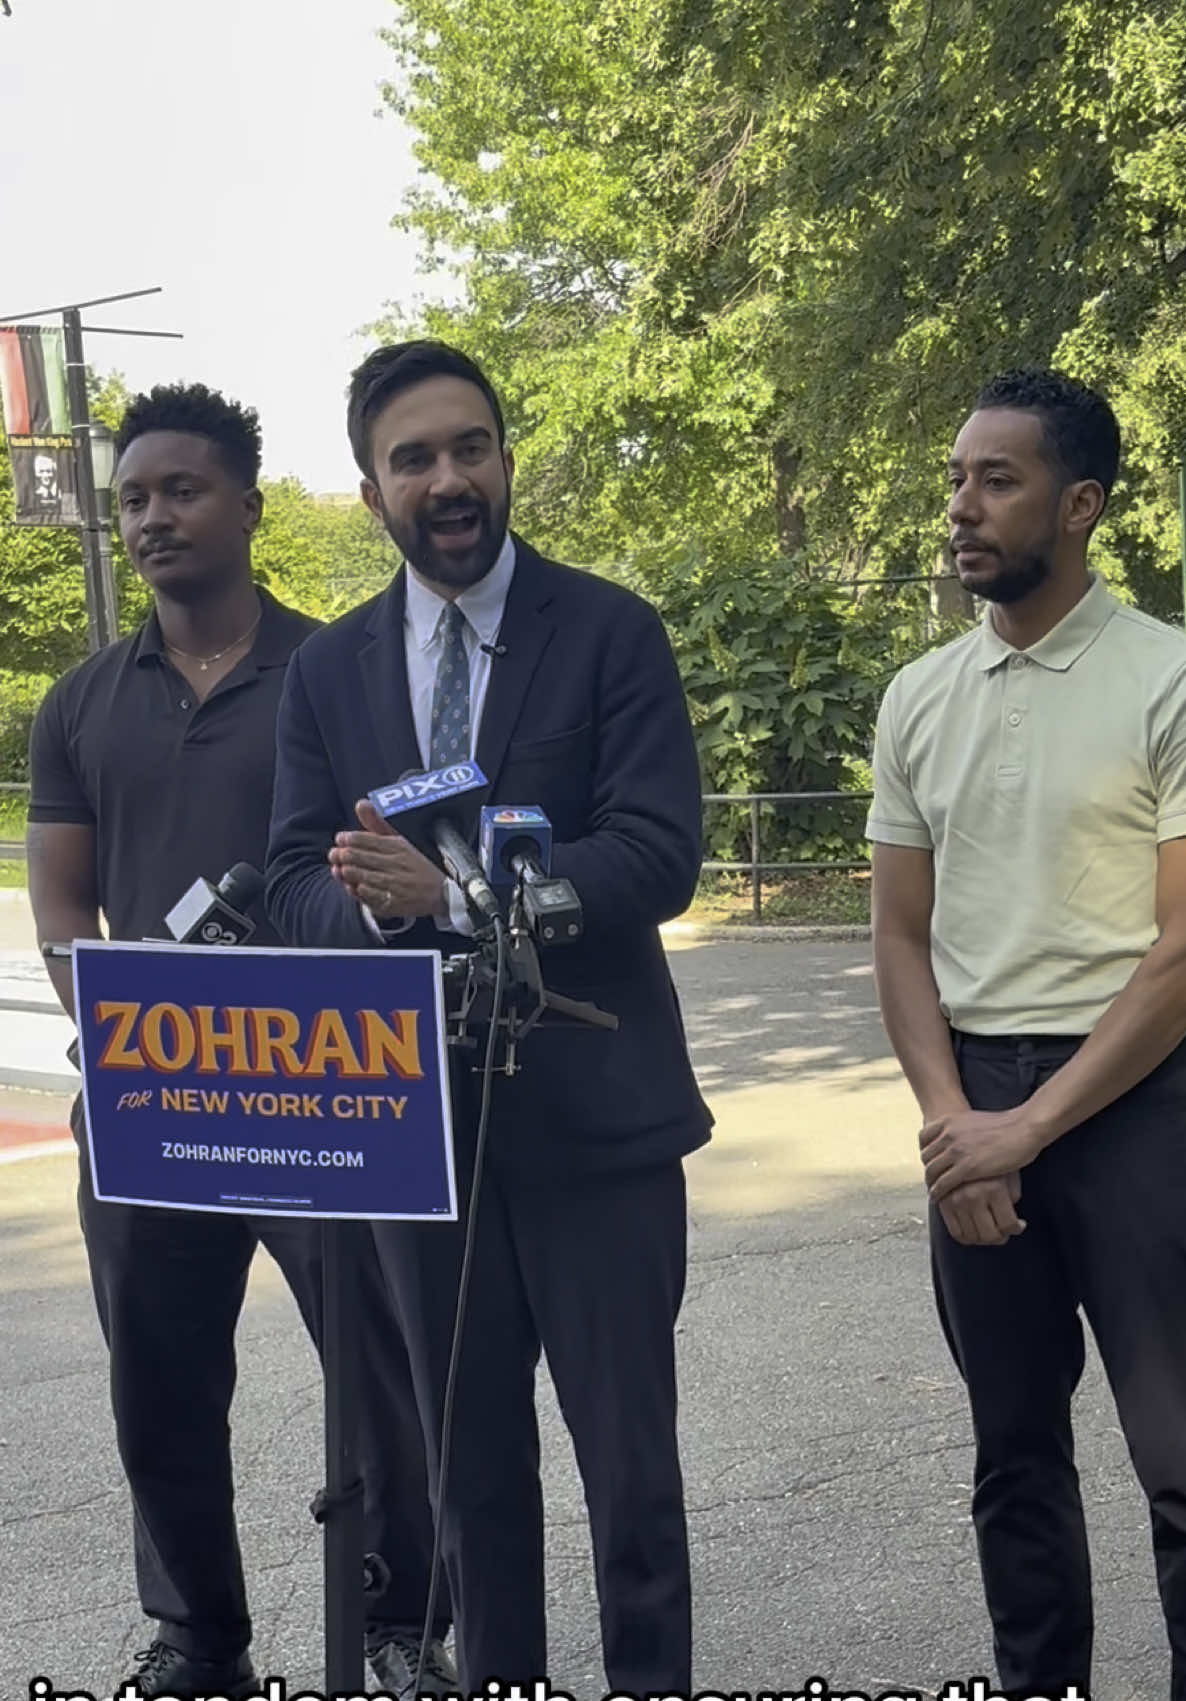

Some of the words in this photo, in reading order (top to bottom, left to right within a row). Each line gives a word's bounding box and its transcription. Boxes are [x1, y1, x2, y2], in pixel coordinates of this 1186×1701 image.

[377, 774, 446, 807] PIX
[94, 1001, 424, 1078] ZOHRAN
[116, 1090, 152, 1111] FOR
[161, 1087, 229, 1114] NEW
[236, 1091, 324, 1118] YORK
[332, 1095, 408, 1119] CITY
[161, 1142, 364, 1167] ZOHRANFORNYC.COM
